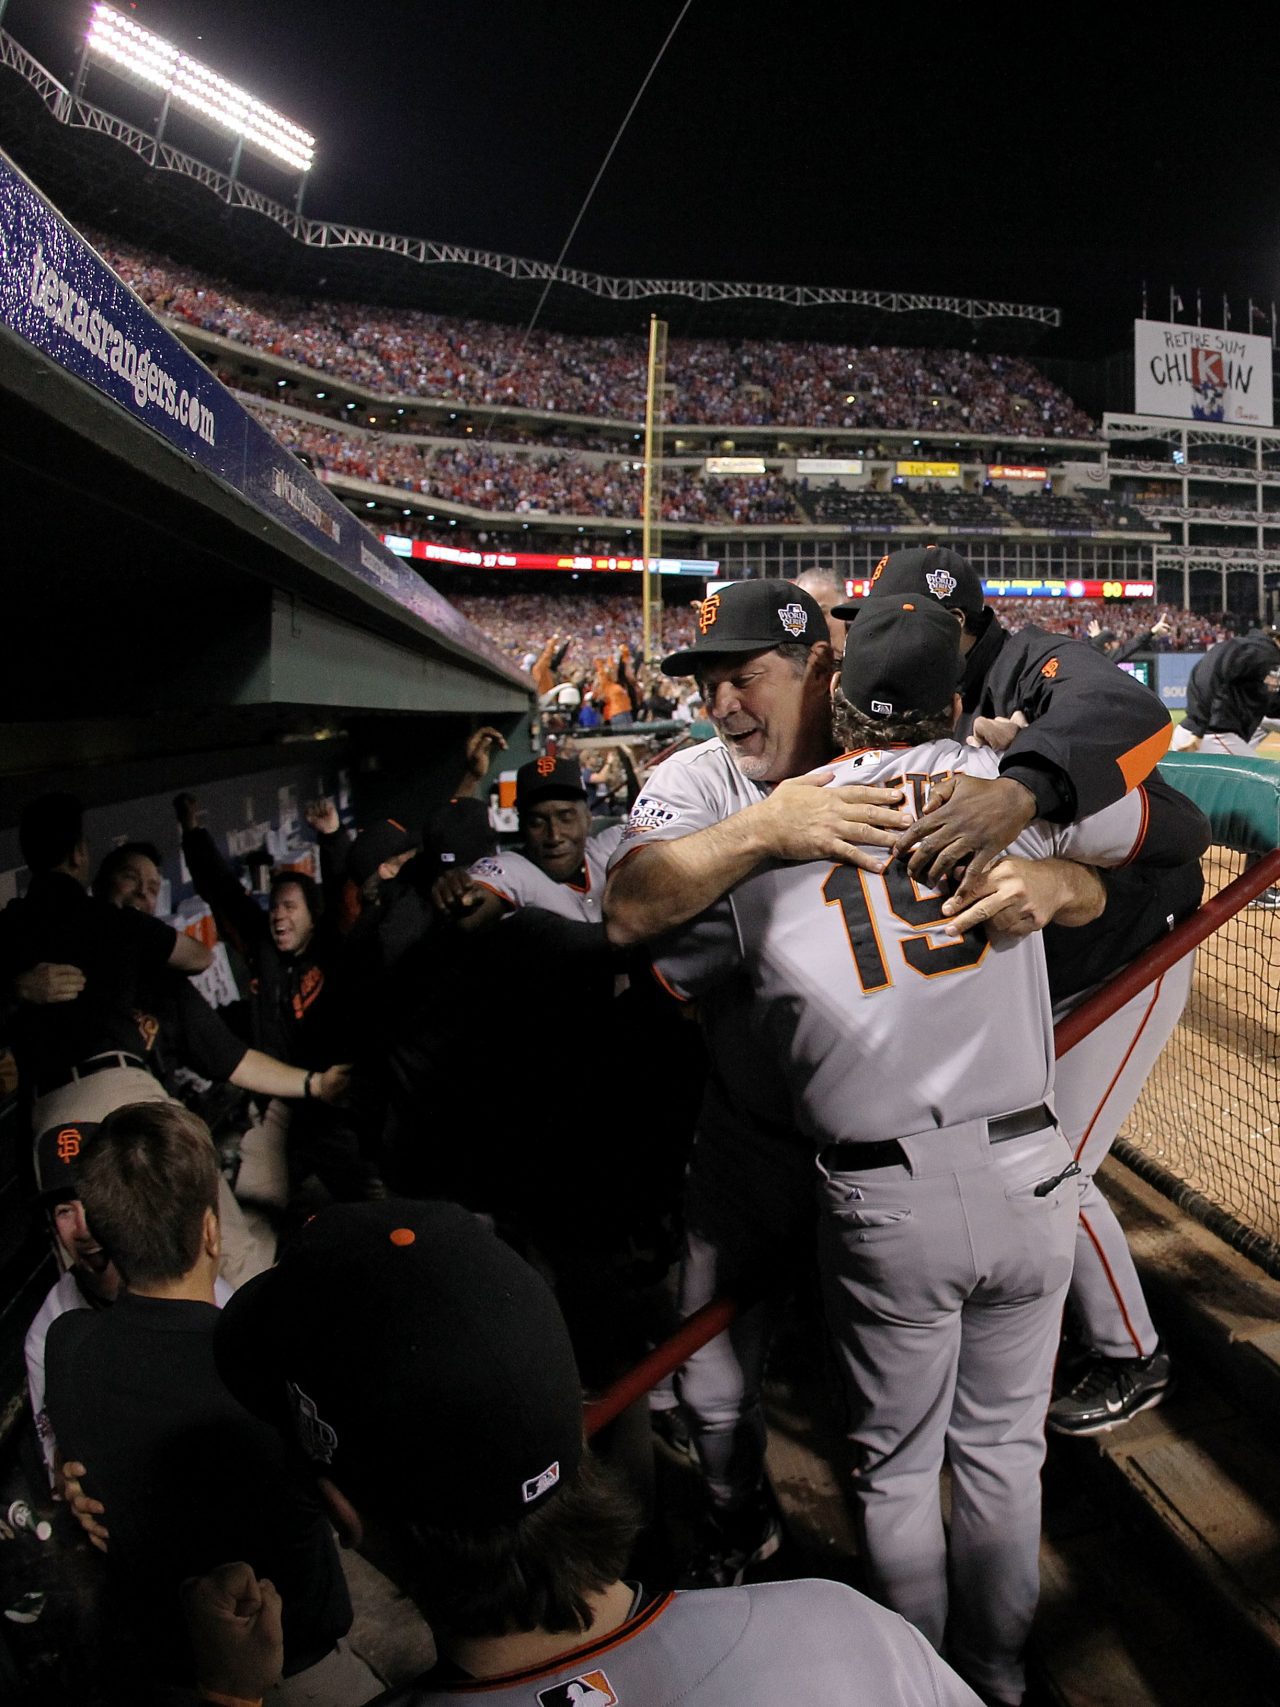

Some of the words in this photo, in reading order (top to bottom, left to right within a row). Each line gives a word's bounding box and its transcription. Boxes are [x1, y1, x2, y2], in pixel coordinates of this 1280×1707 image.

[1164, 331, 1210, 349] RETIRE
[1215, 335, 1246, 358] SUM
[1125, 582, 1154, 598] MPH
[57, 1128, 82, 1164] SF
